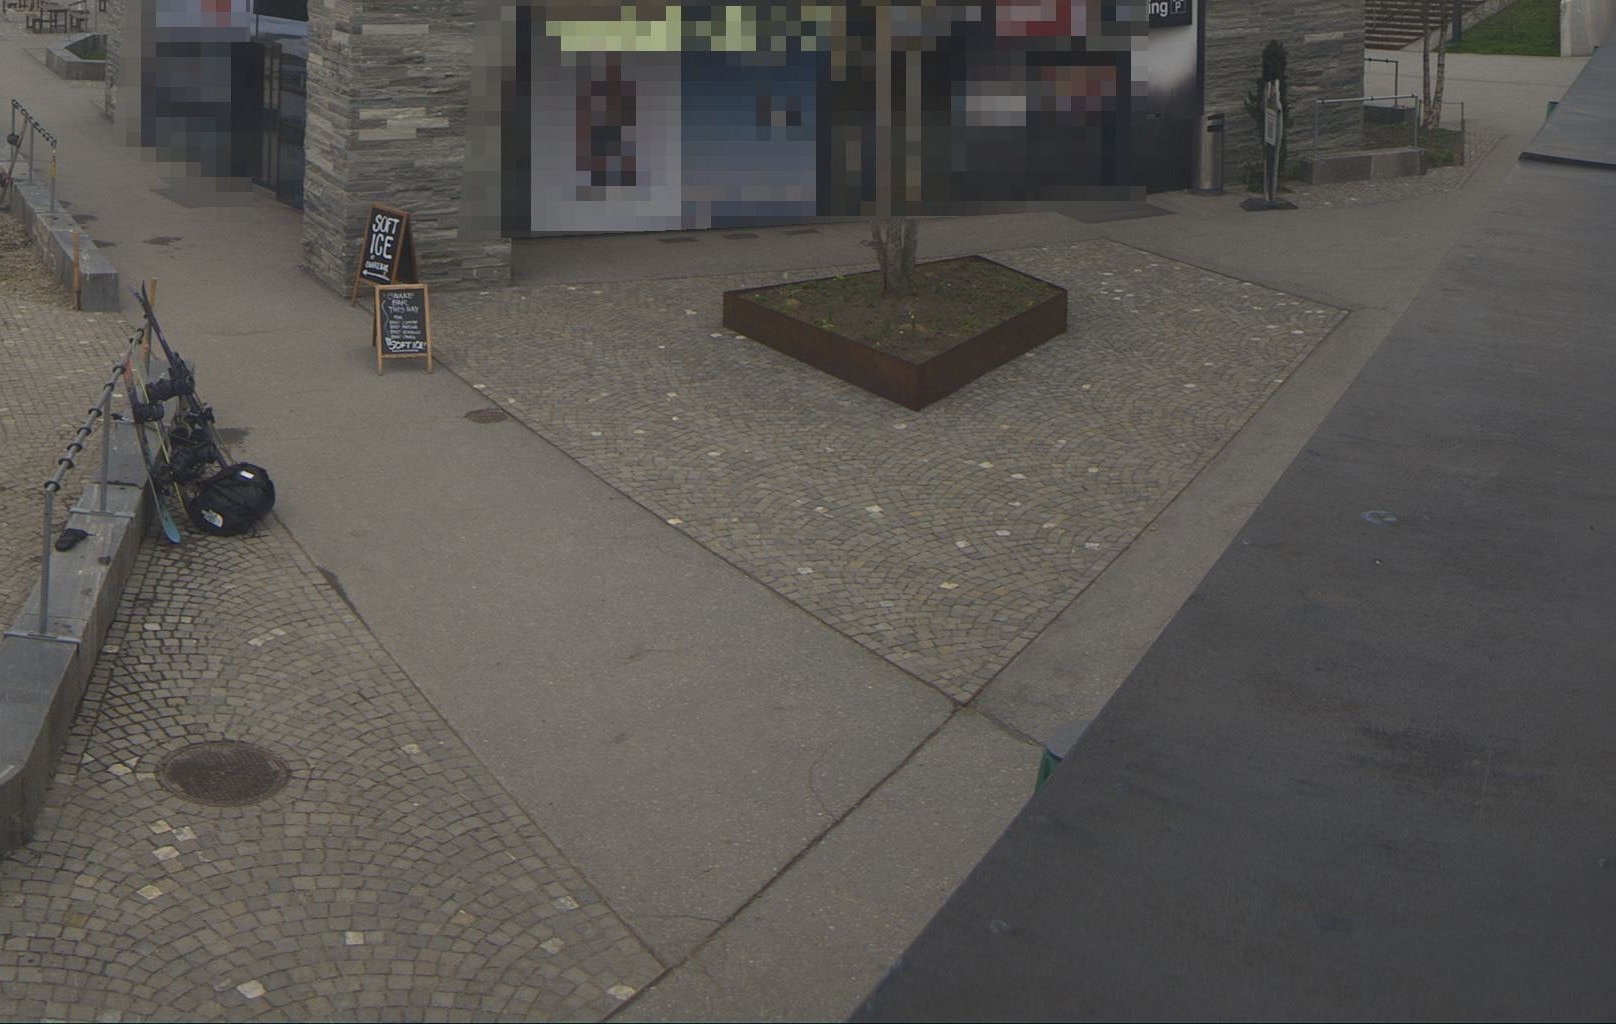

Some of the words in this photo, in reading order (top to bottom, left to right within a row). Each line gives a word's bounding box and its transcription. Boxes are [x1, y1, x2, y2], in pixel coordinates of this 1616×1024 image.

[1148, 0, 1168, 17] ing
[372, 214, 400, 235] SOFT
[370, 233, 394, 260] ICE
[389, 340, 412, 350] SOFT
